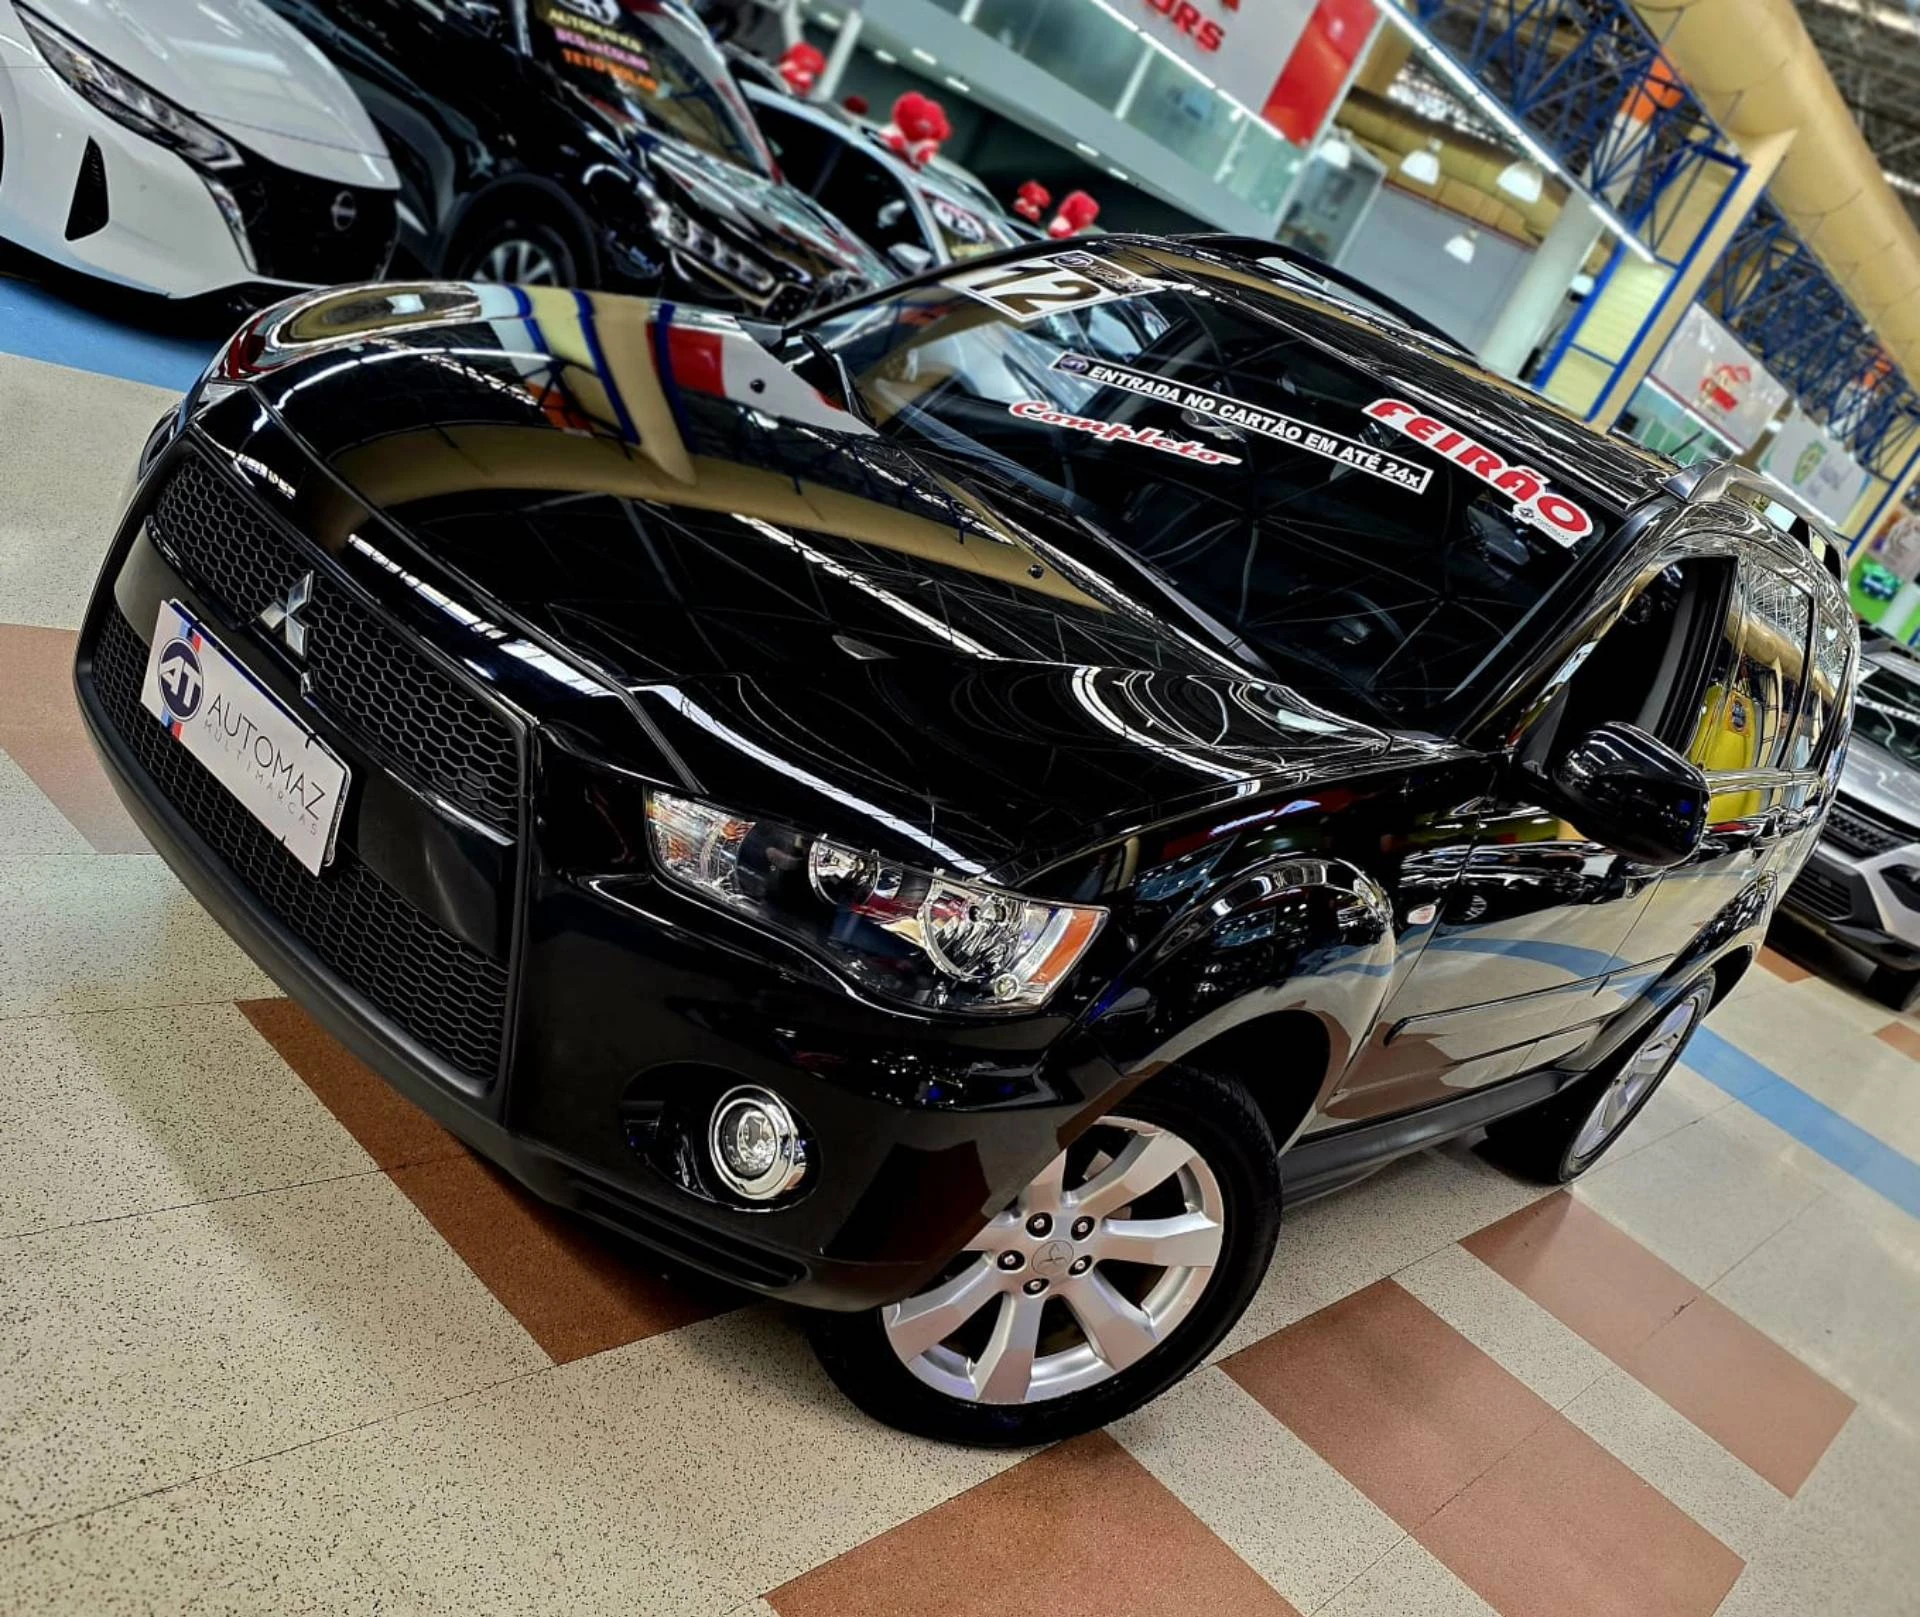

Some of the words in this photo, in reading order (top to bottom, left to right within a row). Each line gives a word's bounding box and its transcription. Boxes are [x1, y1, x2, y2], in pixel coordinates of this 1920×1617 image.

[968, 265, 1102, 315] 12
[1010, 401, 1241, 465] Completo
[1088, 366, 1179, 401] ENTRADA
[1183, 394, 1216, 412] NO
[1219, 404, 1302, 441] CARTÃO
[1303, 433, 1339, 455] EM
[1338, 445, 1382, 471] ATÉ
[1381, 462, 1422, 488] 24x
[1368, 399, 1588, 533] FEIRÃO
[203, 718, 317, 836] MULTIMARCAS
[206, 693, 326, 821] AUTOMAZ
